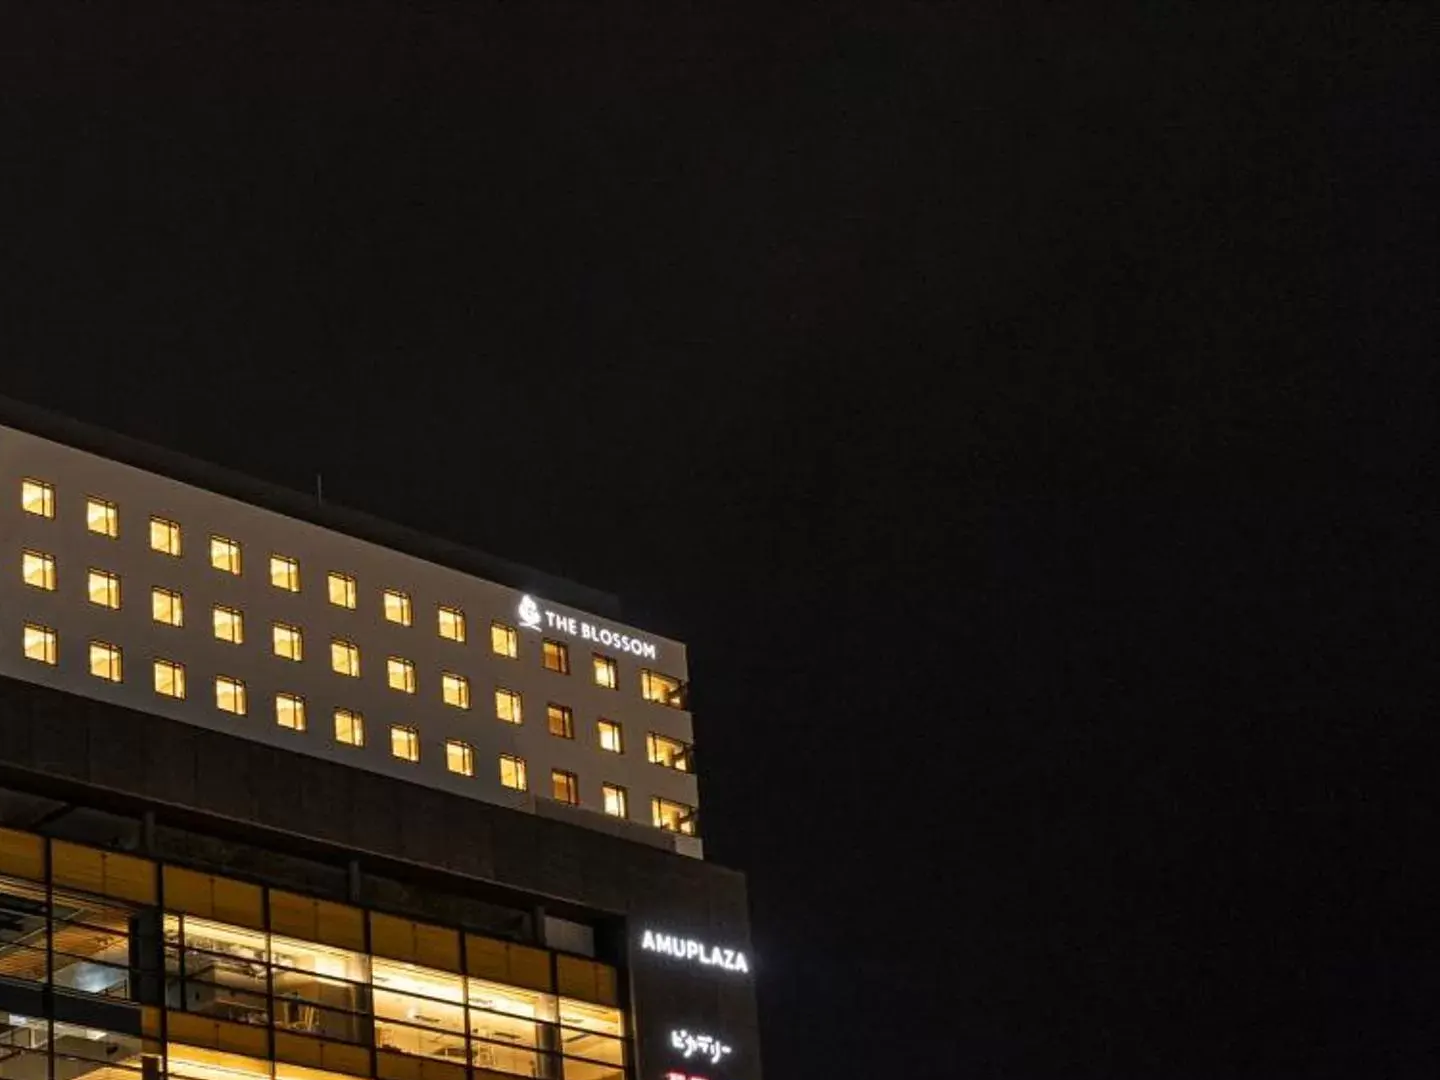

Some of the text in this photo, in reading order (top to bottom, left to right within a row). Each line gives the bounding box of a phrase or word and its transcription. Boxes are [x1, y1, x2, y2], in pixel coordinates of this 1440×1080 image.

[545, 611, 656, 660] THE BLOSSOM
[642, 930, 749, 974] AMUPLAZA
